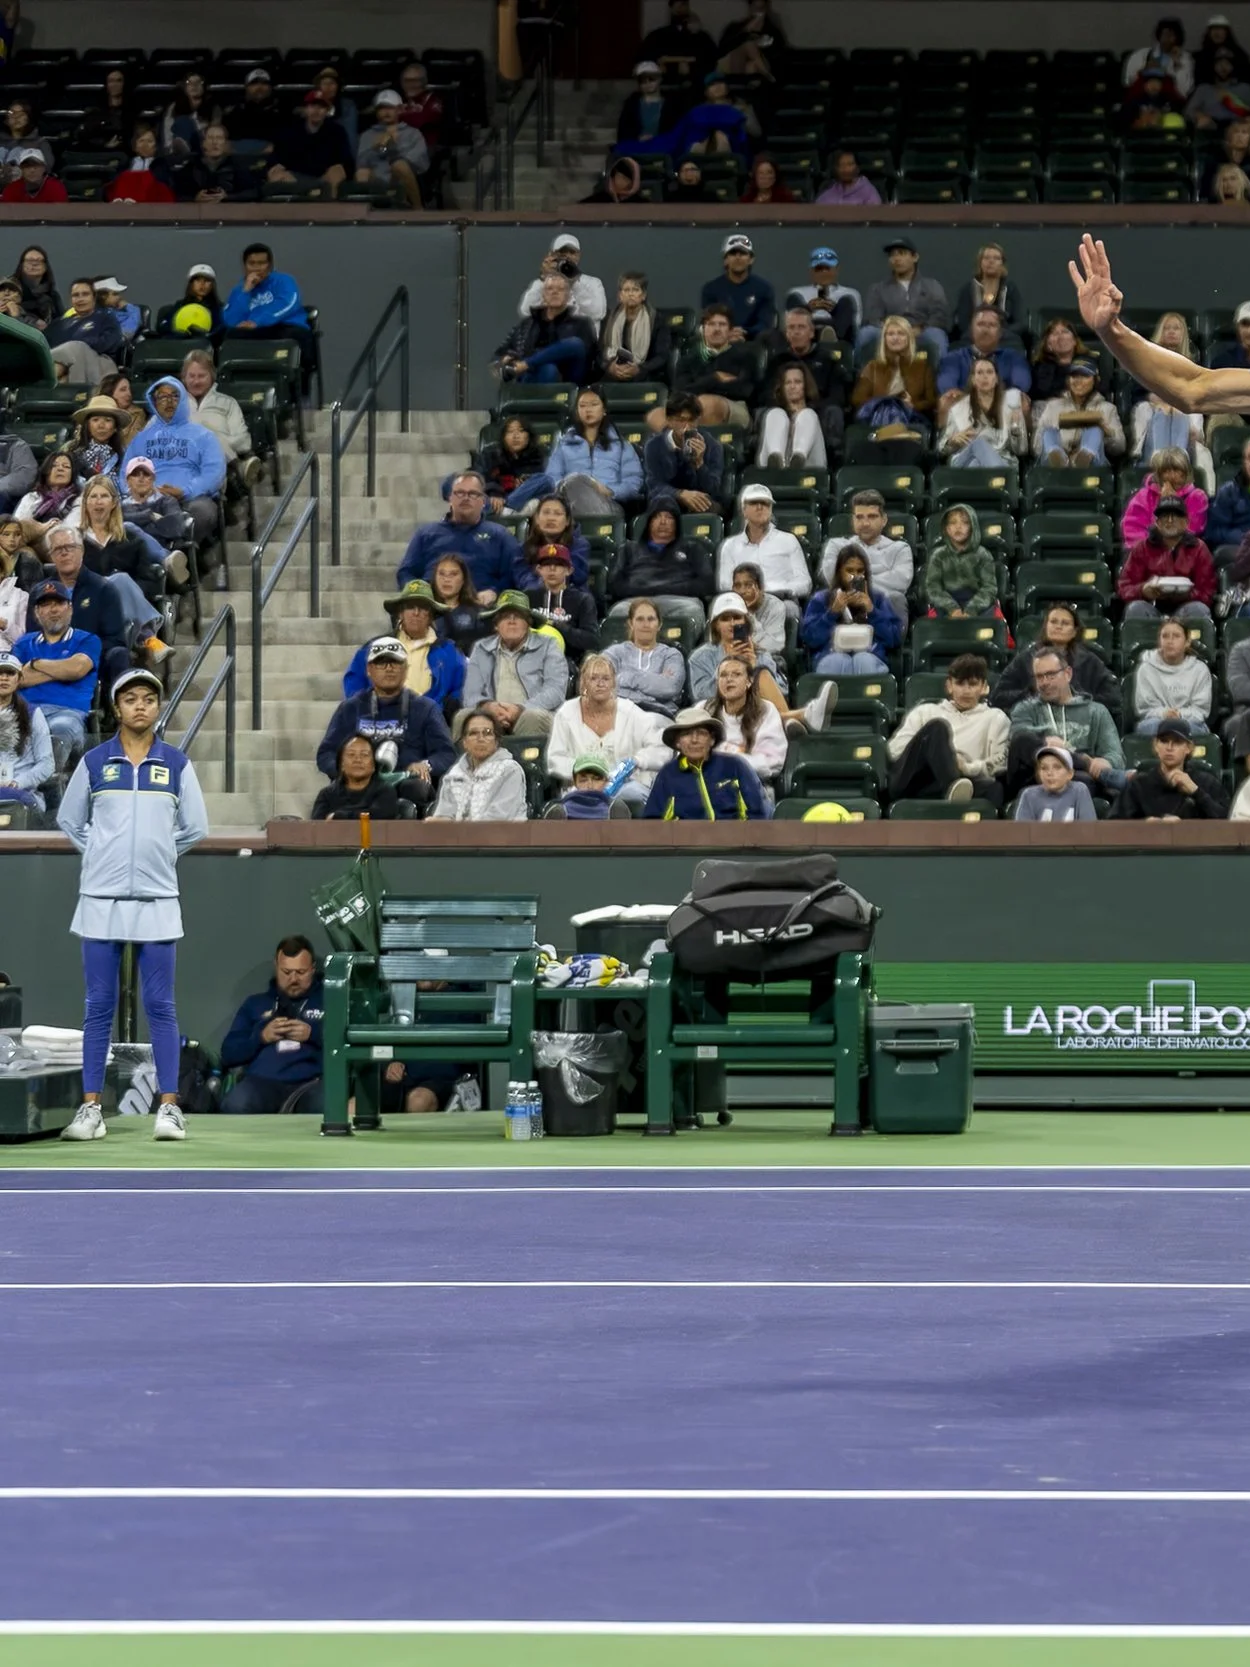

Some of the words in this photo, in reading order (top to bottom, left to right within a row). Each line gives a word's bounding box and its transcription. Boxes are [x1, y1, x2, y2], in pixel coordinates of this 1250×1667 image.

[1004, 1005, 1052, 1035] LA
[1056, 1005, 1186, 1035] ROCHE
[1057, 1036, 1156, 1049] LABORATOIRE
